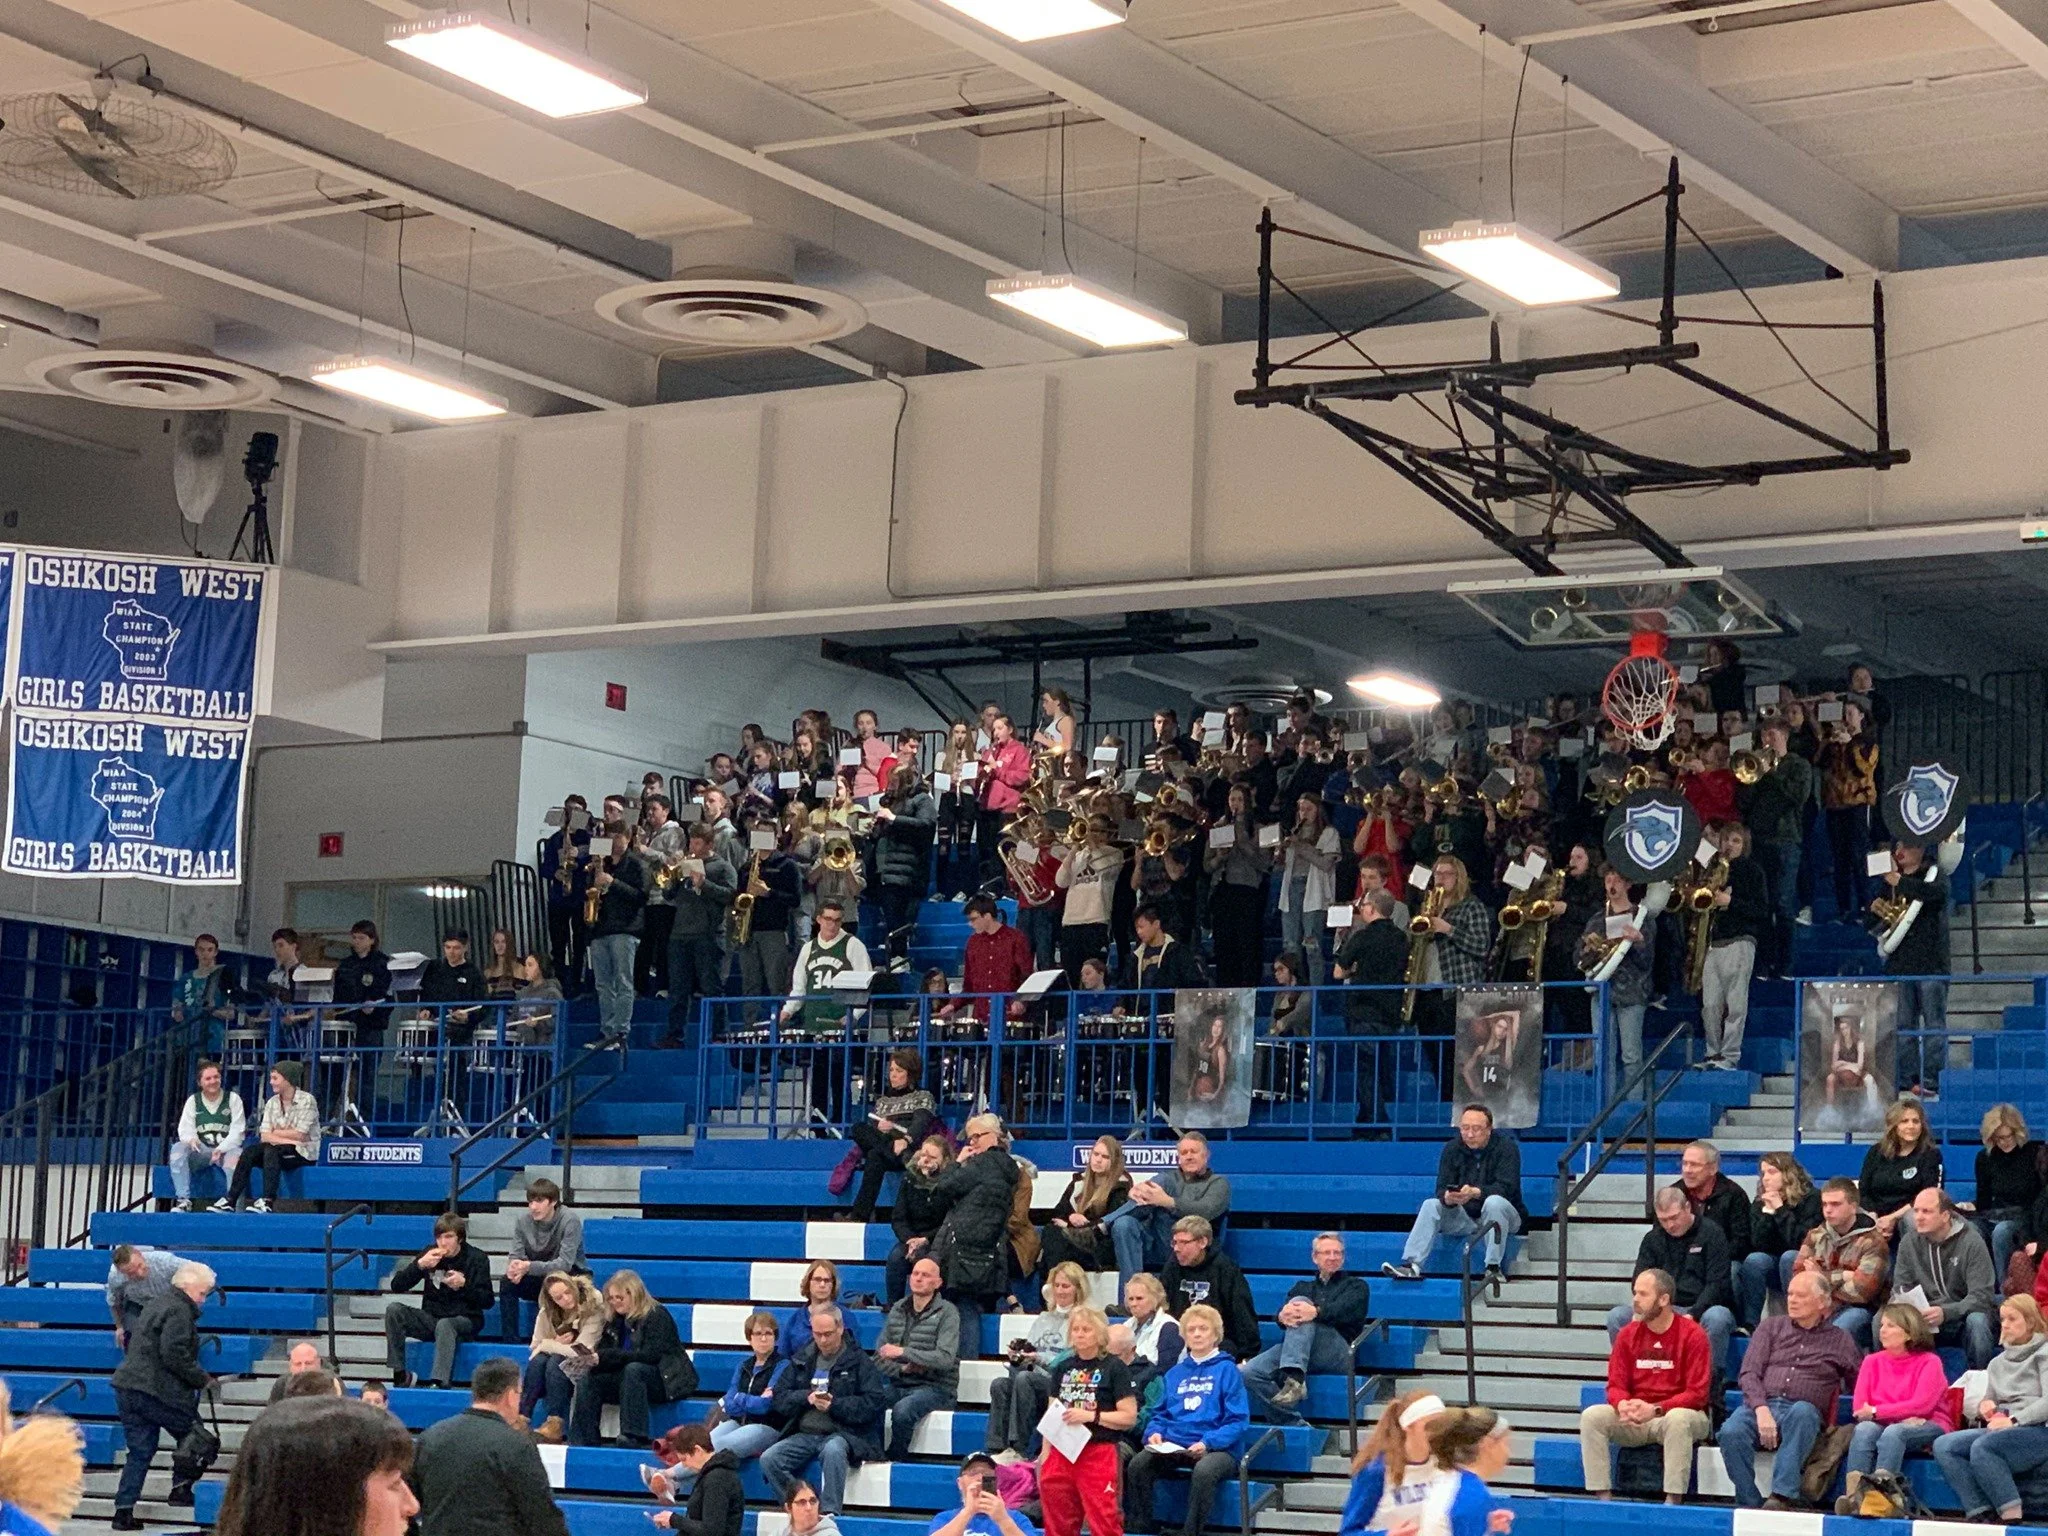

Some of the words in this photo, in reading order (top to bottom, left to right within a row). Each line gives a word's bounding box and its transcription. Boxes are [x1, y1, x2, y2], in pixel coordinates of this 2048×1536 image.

[28, 556, 158, 595] OSHKOSH
[180, 568, 261, 601] WEST
[116, 608, 141, 617] WIAA
[123, 621, 153, 632] STATE
[115, 634, 164, 646] CHAMPION
[18, 676, 85, 710] GIRLS
[98, 682, 249, 721] BASKETBALL
[18, 718, 145, 753] OSHKOSH
[164, 729, 244, 760] WEST
[102, 768, 126, 778] WIAA
[110, 782, 138, 792] STATE
[102, 793, 149, 806] CHAMPION
[10, 837, 76, 871] GIRLS
[88, 843, 235, 879] BASKETBALL
[813, 969, 833, 990] 34
[330, 1146, 361, 1161] WEST
[362, 1146, 421, 1161] STUDENTS
[1121, 1149, 1179, 1165] TUDENT
